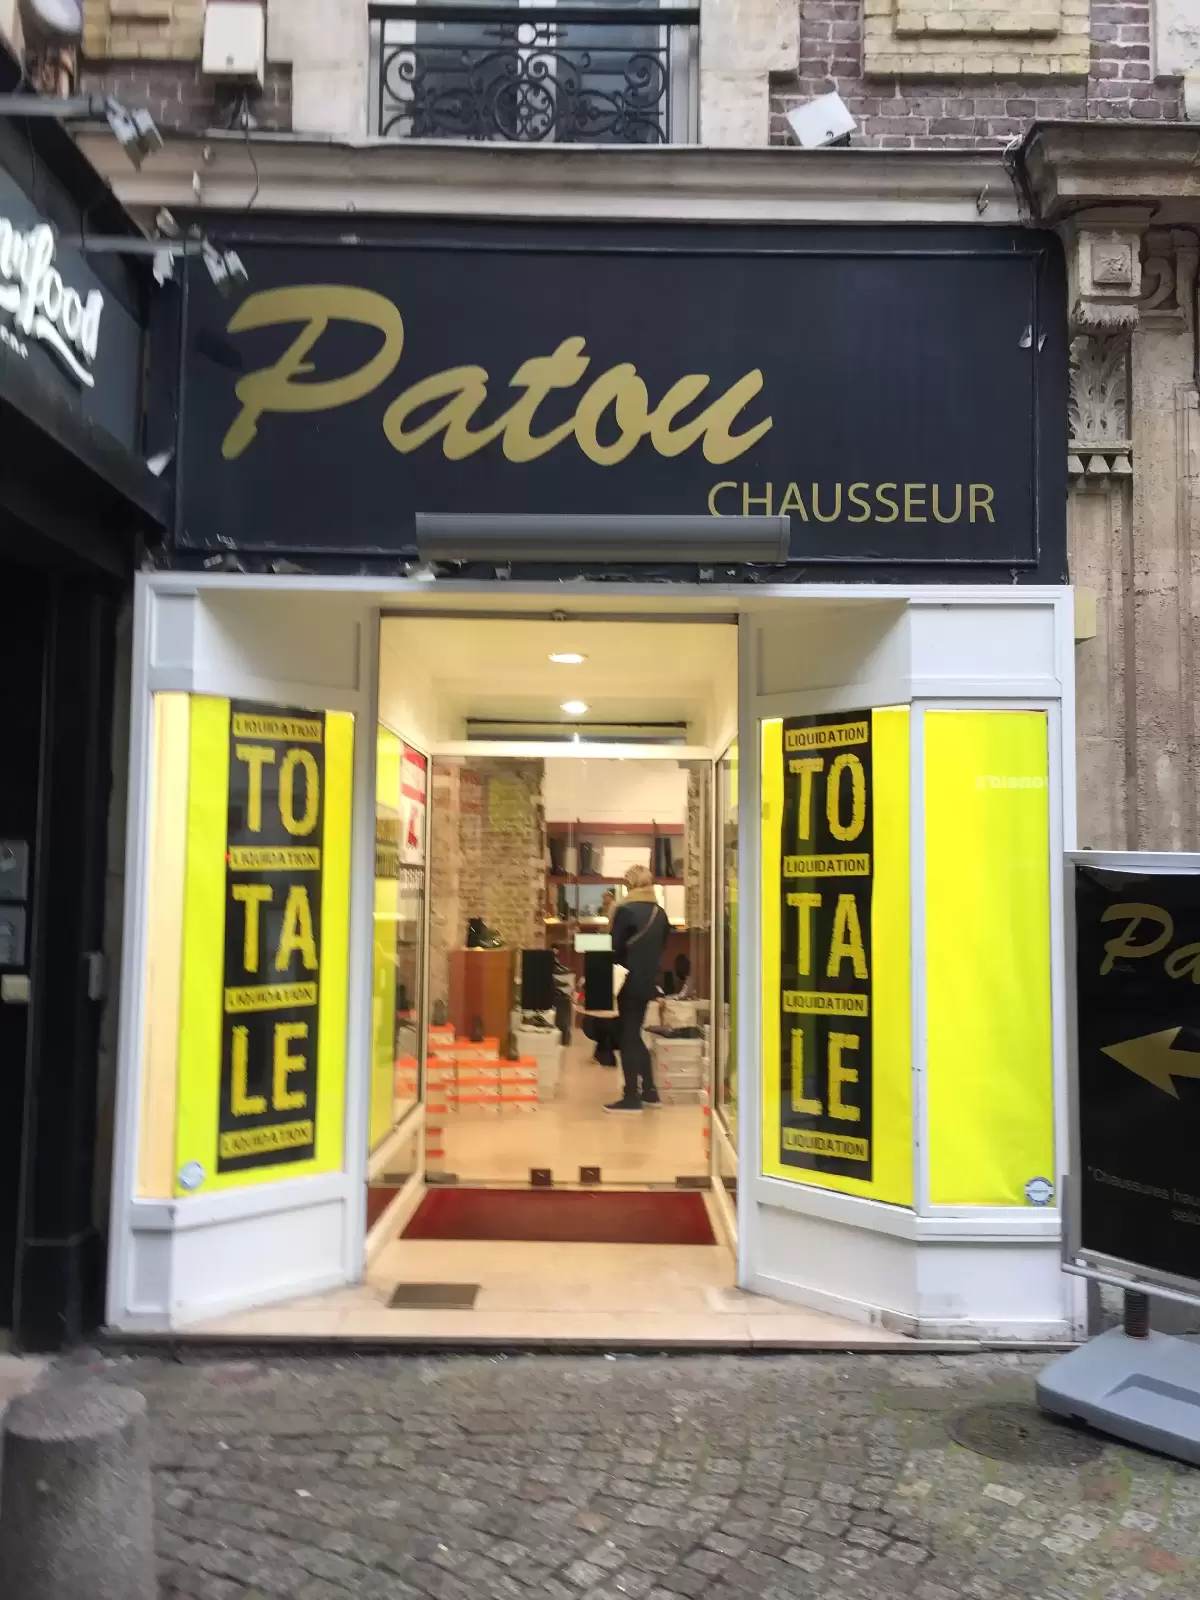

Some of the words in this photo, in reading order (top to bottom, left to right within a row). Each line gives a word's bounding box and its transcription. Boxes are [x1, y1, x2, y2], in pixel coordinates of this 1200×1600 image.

[221, 284, 773, 466] Patou
[707, 481, 996, 524] CHAUSSEUR
[235, 717, 319, 737] LIQUIDATION
[787, 726, 865, 747] LIQUIDATION
[235, 743, 320, 836] TO
[788, 753, 866, 841] TO
[231, 850, 316, 867] LIQUIDATION
[786, 858, 866, 874] LIQUIDATION
[231, 884, 319, 973] TA
[786, 892, 868, 979] TA
[785, 994, 865, 1012] LIQUIDATION
[230, 1021, 309, 1117] LE
[790, 1027, 861, 1122] LE
[784, 1130, 865, 1157] LIQUIDATION
